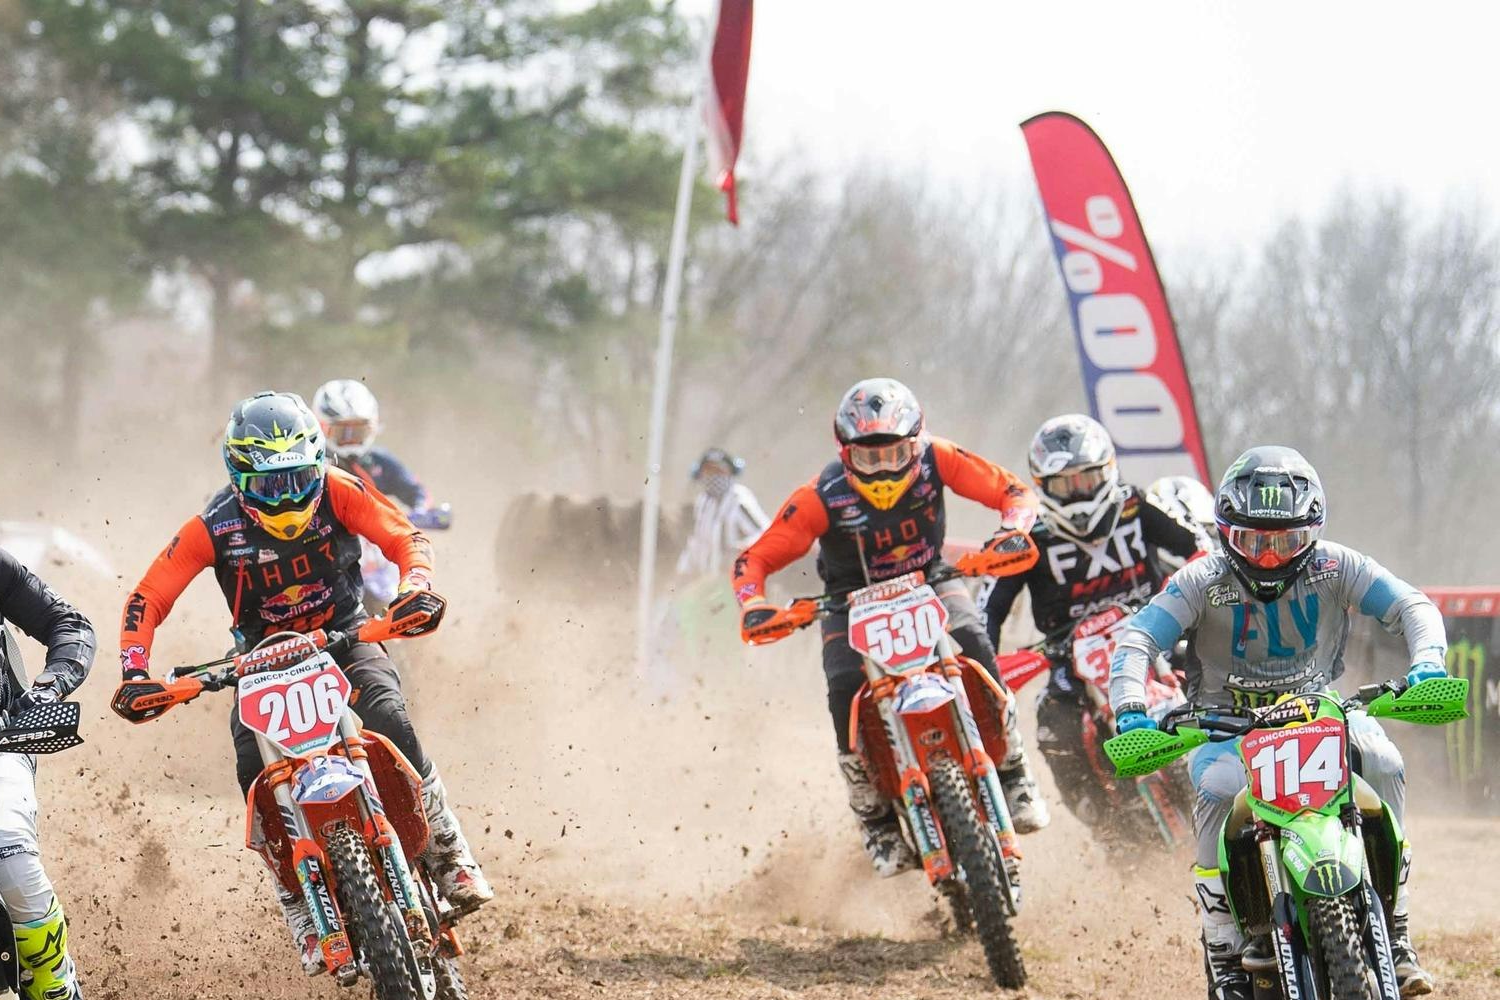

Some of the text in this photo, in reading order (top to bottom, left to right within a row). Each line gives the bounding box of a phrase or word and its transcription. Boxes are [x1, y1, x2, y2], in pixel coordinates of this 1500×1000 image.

[1251, 509, 1292, 517] MONSTER
[1047, 518, 1148, 585] FXR
[865, 604, 942, 663] 530
[1231, 592, 1319, 659] FLY
[244, 646, 312, 674] RENTHA
[259, 674, 343, 742] 206
[1258, 726, 1341, 744] GNCCRACING.COM
[1252, 736, 1342, 802] 114
[308, 859, 339, 931] DNLOP
[1369, 911, 1396, 1000] DUNLOP
